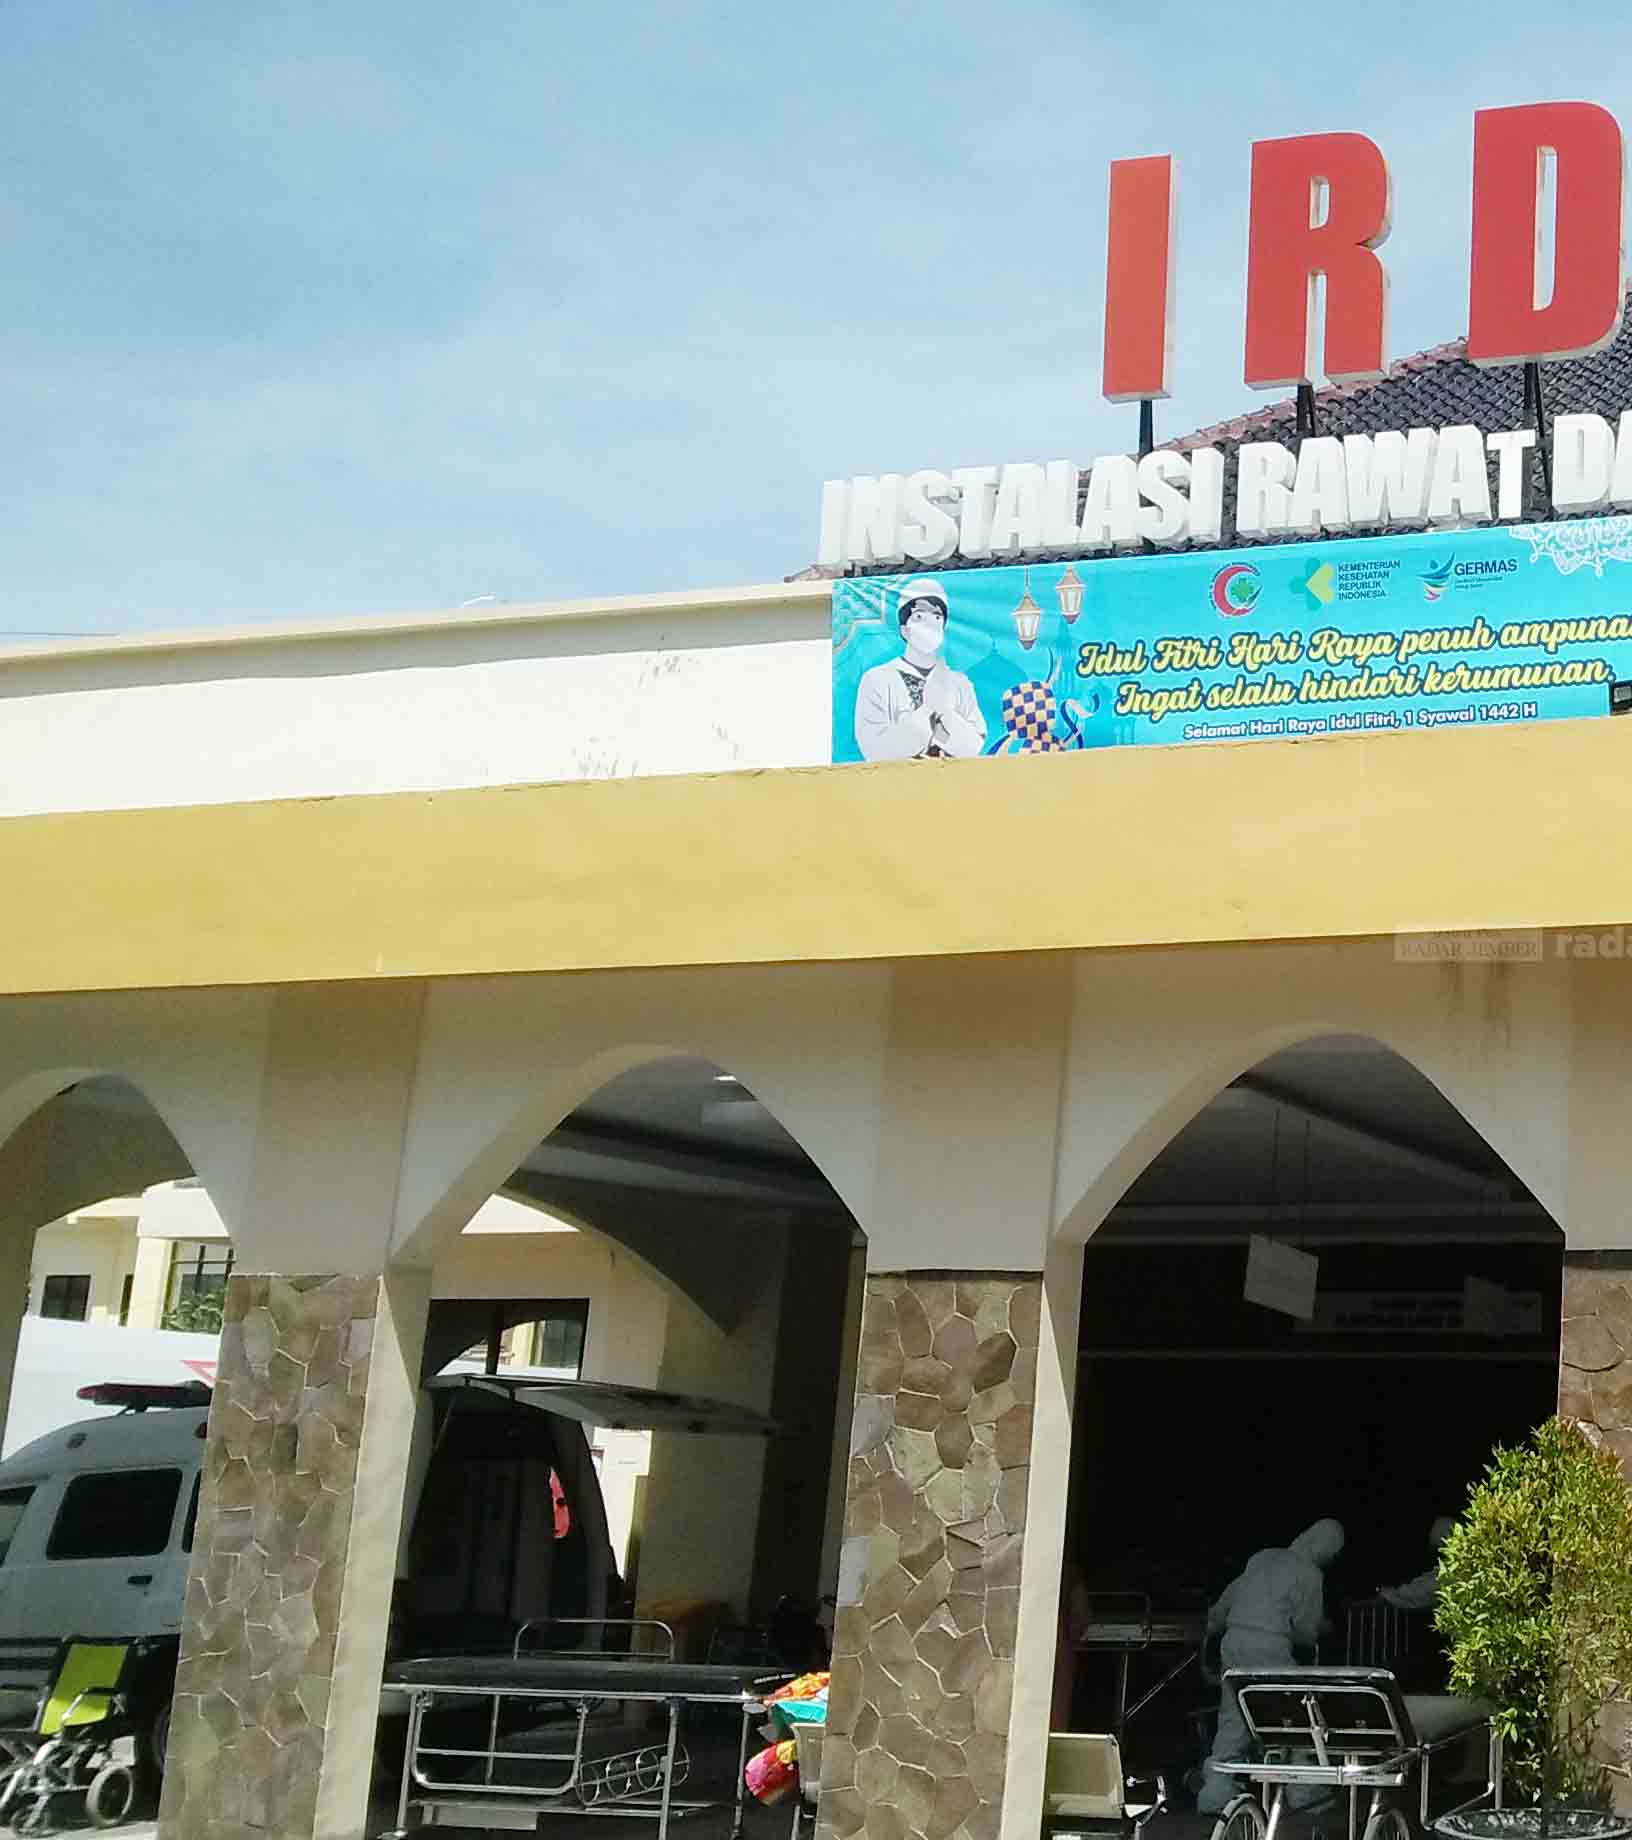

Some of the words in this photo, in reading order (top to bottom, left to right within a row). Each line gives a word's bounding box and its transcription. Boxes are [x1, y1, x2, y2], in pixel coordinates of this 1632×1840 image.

[1102, 101, 1628, 404] IRD
[819, 448, 1225, 565] INSTALASI
[1236, 426, 1537, 537] RAWAT
[1338, 560, 1400, 573] KEMENTERIAN
[1338, 571, 1390, 582] KESEHATAN
[1454, 558, 1518, 576] GERMAS
[1338, 580, 1382, 591] REPUBLIK
[1338, 590, 1386, 601] INDONESIA
[1078, 641, 1147, 678] Idul
[1152, 636, 1222, 673] Fitri
[1228, 631, 1303, 672] Hari
[1309, 627, 1400, 666] Raya
[1396, 616, 1496, 663] penuh
[1116, 679, 1202, 721] Ingat
[1205, 675, 1295, 709] selalu
[1299, 664, 1421, 704] hindari
[1184, 722, 1248, 740] Selamat
[1250, 718, 1286, 736] Hari
[1288, 716, 1326, 737] Raya
[1330, 714, 1362, 732] Idul
[1364, 711, 1400, 729] Fitri,
[1404, 712, 1413, 726] 1
[1417, 708, 1474, 727] Syawal
[1479, 705, 1521, 721] 1442
[1523, 703, 1537, 718] H
